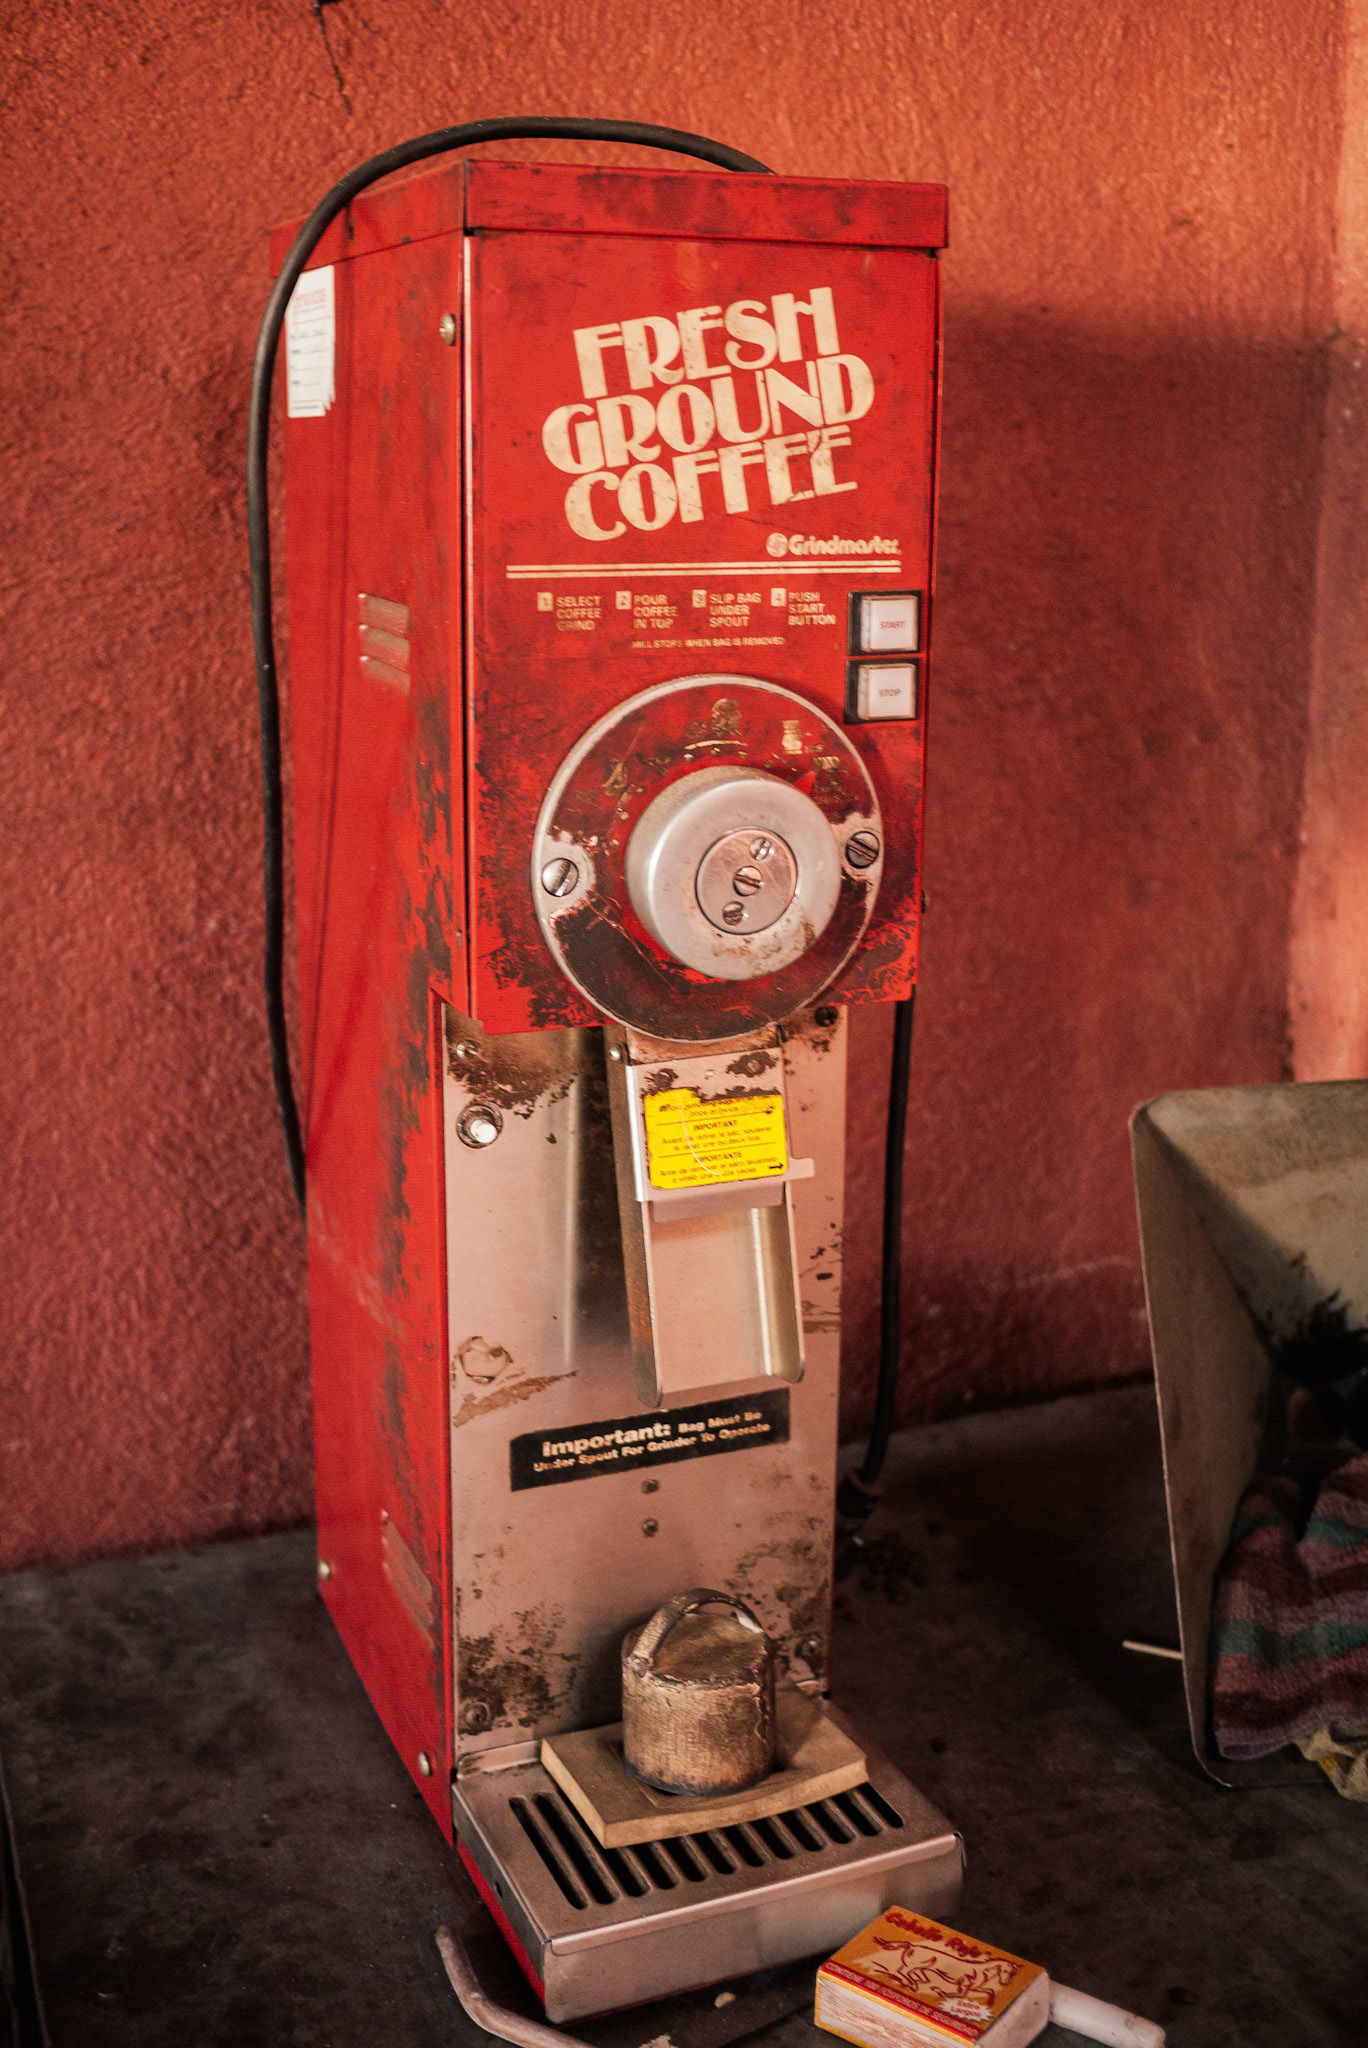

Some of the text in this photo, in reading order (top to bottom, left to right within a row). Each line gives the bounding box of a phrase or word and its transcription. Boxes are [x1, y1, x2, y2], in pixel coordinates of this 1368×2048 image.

[573, 287, 840, 399] FRESH
[542, 354, 875, 475] GROUND
[565, 425, 858, 541] COFFEE
[557, 595, 601, 607] SELECT
[634, 594, 668, 606] POUR
[709, 593, 735, 604] SLIP
[737, 592, 761, 603] BAG
[788, 591, 820, 602] PUSH
[556, 608, 602, 619] COFFEE
[633, 606, 678, 617] COFFEE
[709, 605, 750, 615] UNDER
[788, 603, 825, 614] START
[634, 618, 674, 629] IN TOP
[709, 616, 750, 627] SPOUT
[788, 614, 836, 625] BUTTON
[879, 620, 906, 630] START
[556, 620, 596, 631] GRIND
[878, 688, 902, 698] STOP
[542, 1411, 762, 1457] Important: Bag Must Be
[533, 1423, 771, 1472] Under Spout For Grinder To Operate
